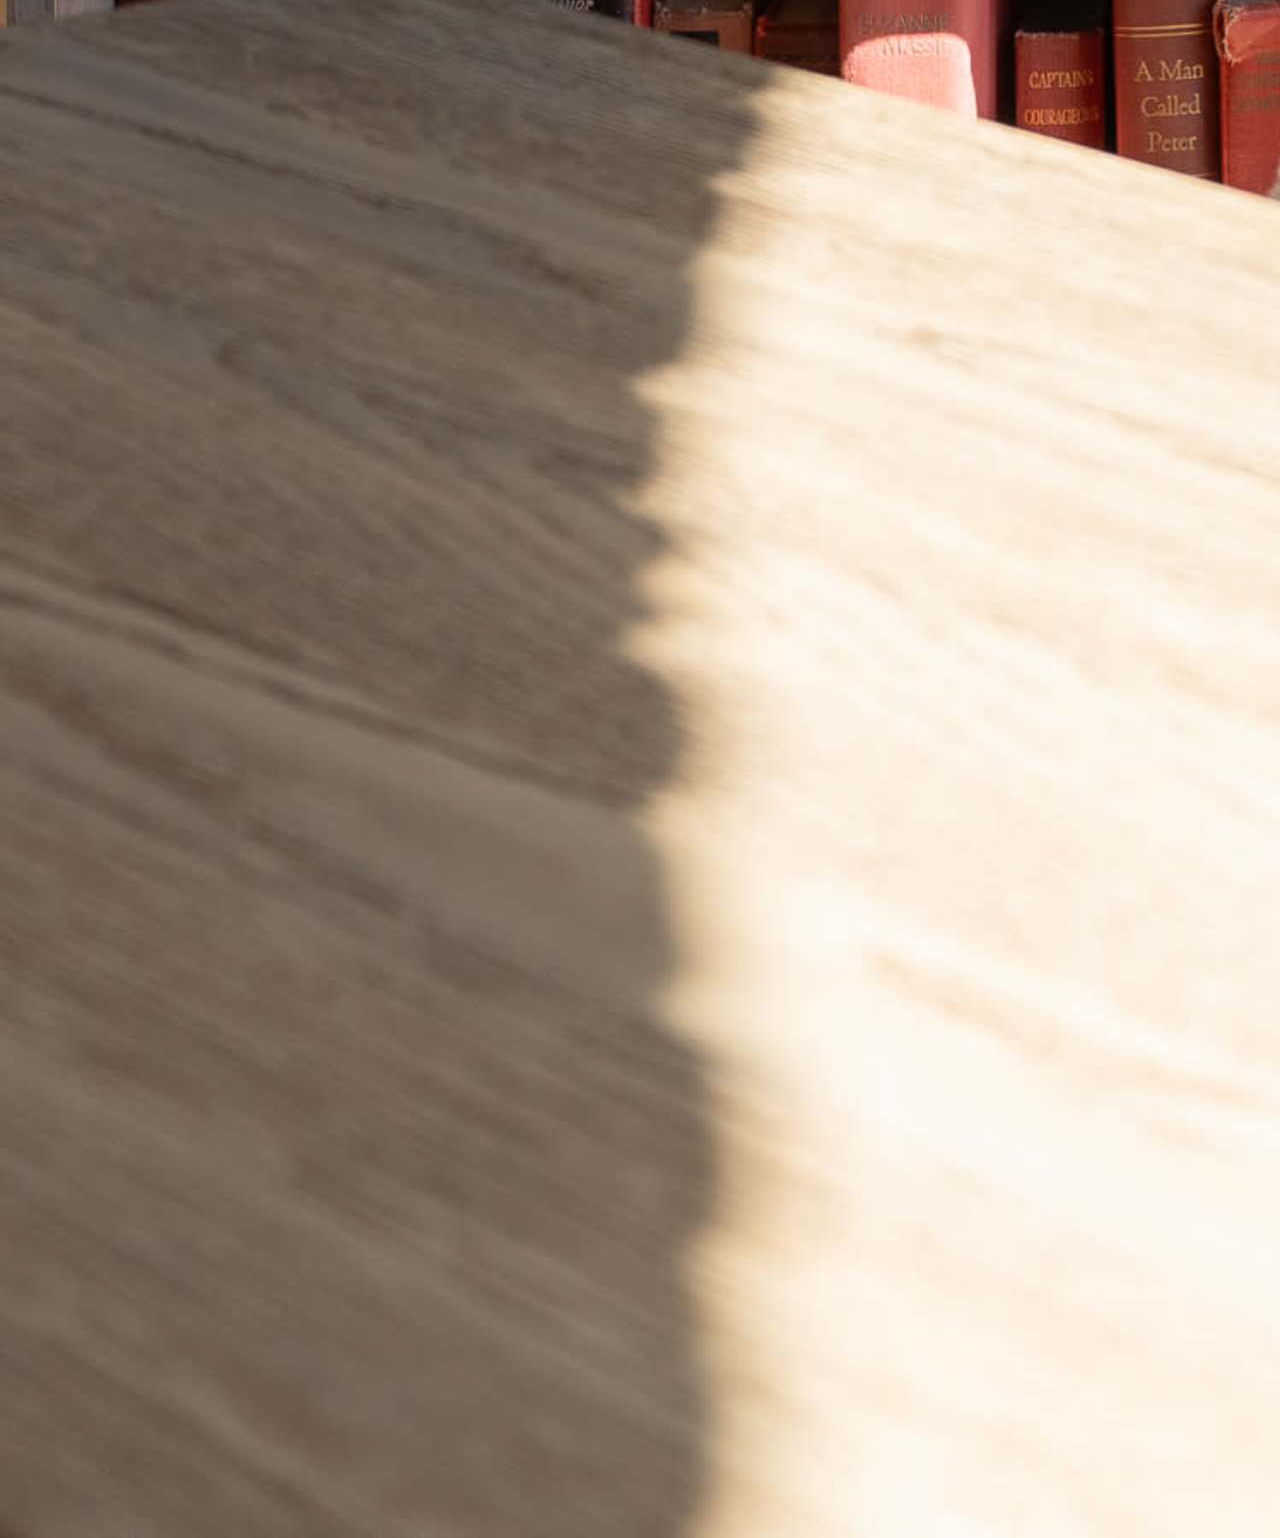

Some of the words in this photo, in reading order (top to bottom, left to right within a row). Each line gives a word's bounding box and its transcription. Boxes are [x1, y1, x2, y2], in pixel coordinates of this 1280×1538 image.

[1134, 62, 1154, 83] A
[1158, 59, 1204, 82] Man
[1140, 93, 1201, 118] Called
[1147, 131, 1198, 153] Peter
